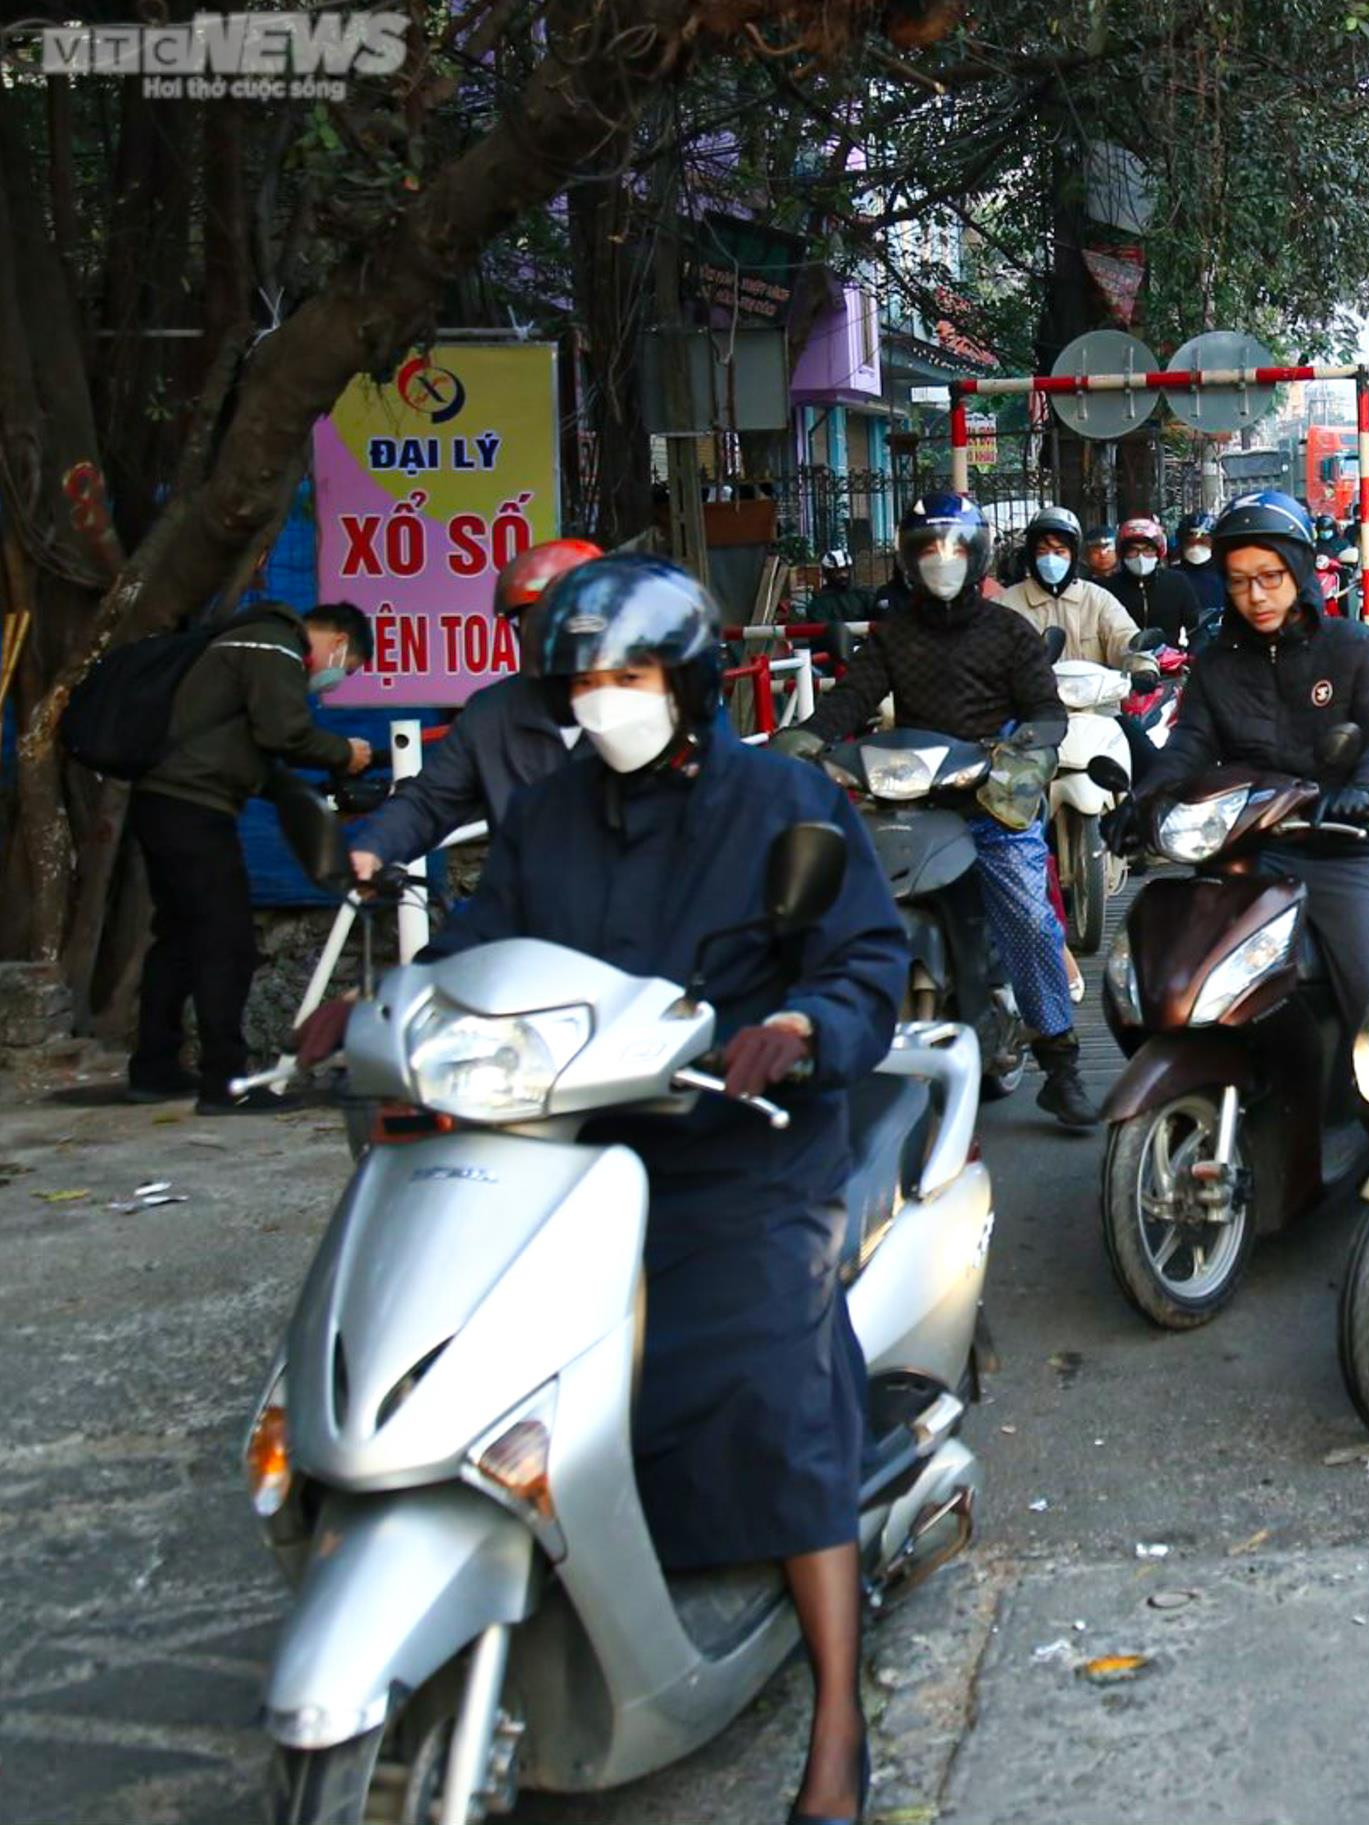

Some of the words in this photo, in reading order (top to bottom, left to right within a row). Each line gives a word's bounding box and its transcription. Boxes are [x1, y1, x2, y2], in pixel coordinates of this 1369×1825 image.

[370, 438, 440, 476] ĐẠI
[453, 432, 499, 469] LÝ
[339, 491, 428, 578] XỔ
[447, 492, 532, 578] SỐ
